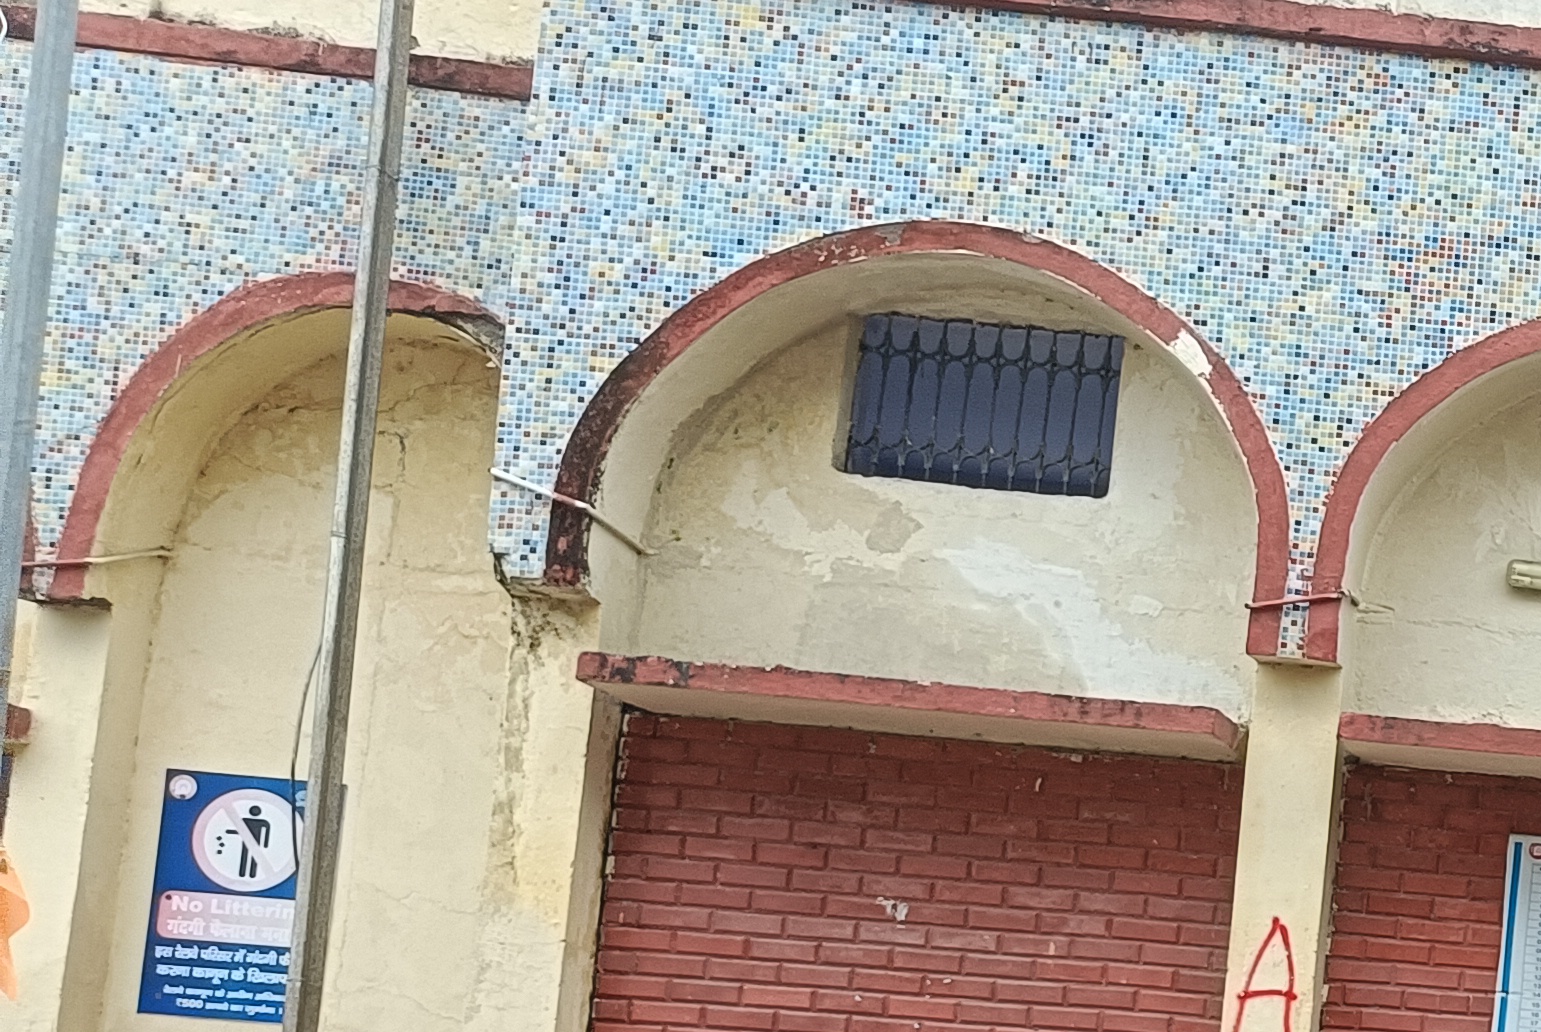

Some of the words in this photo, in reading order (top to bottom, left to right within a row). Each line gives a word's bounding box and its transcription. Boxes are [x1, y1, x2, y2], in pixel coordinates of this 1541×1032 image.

[171, 894, 203, 913] No
[210, 897, 294, 920] Litterin
[166, 915, 206, 936] गंदगी
